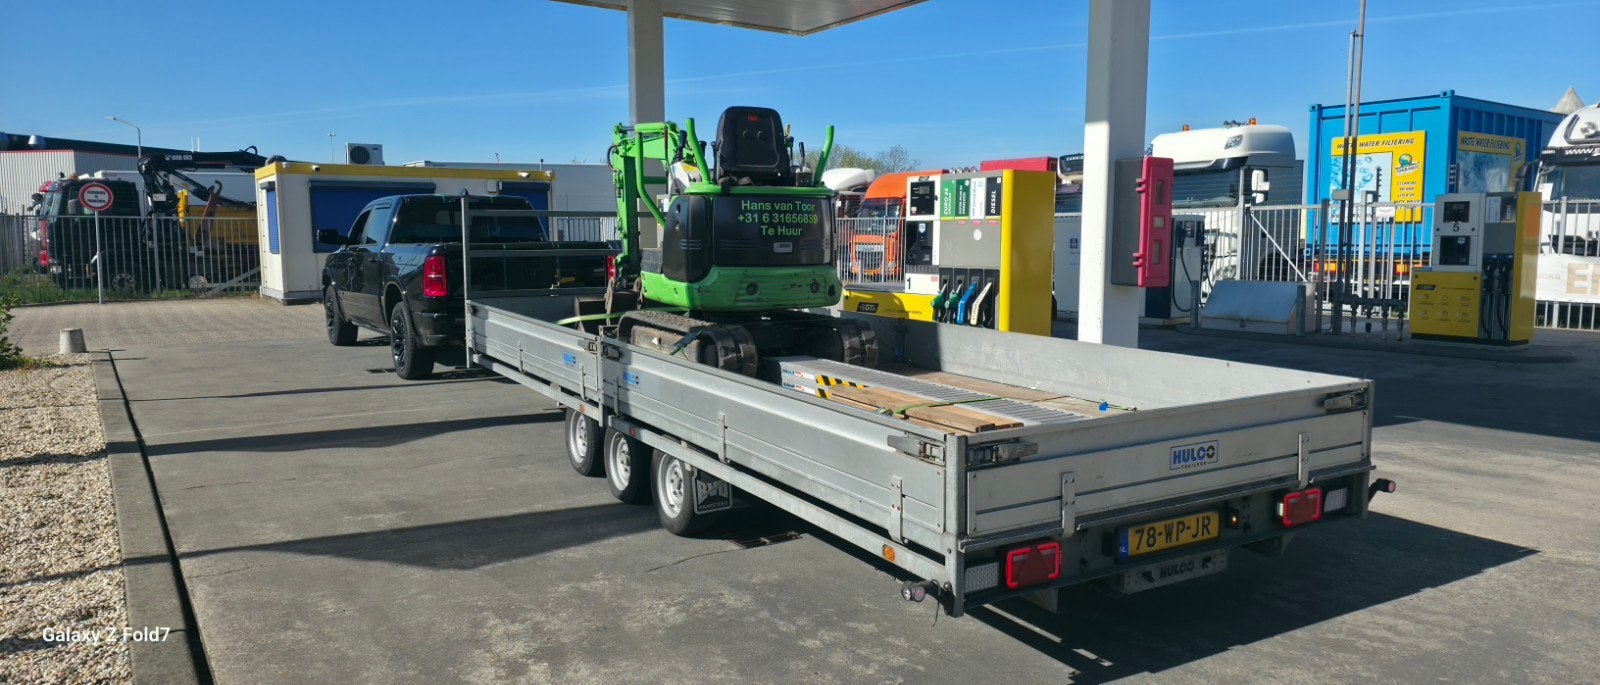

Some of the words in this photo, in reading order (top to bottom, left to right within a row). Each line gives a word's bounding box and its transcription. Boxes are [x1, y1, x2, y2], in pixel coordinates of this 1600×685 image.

[1359, 140, 1380, 148] WATER
[1381, 138, 1415, 146] FILTERING
[741, 200, 772, 211] Hans
[774, 202, 793, 211] van
[794, 201, 816, 212] Toor
[738, 212, 759, 223] +31
[762, 212, 770, 223] 6
[772, 213, 819, 225] 31656839
[760, 225, 775, 236] Te
[777, 225, 803, 236] Huur
[1452, 222, 1460, 232] 5
[906, 277, 912, 290] 1
[1172, 445, 1216, 465] HULCO
[1135, 515, 1212, 551] 78-WP-JR
[1160, 561, 1196, 578] HULCO
